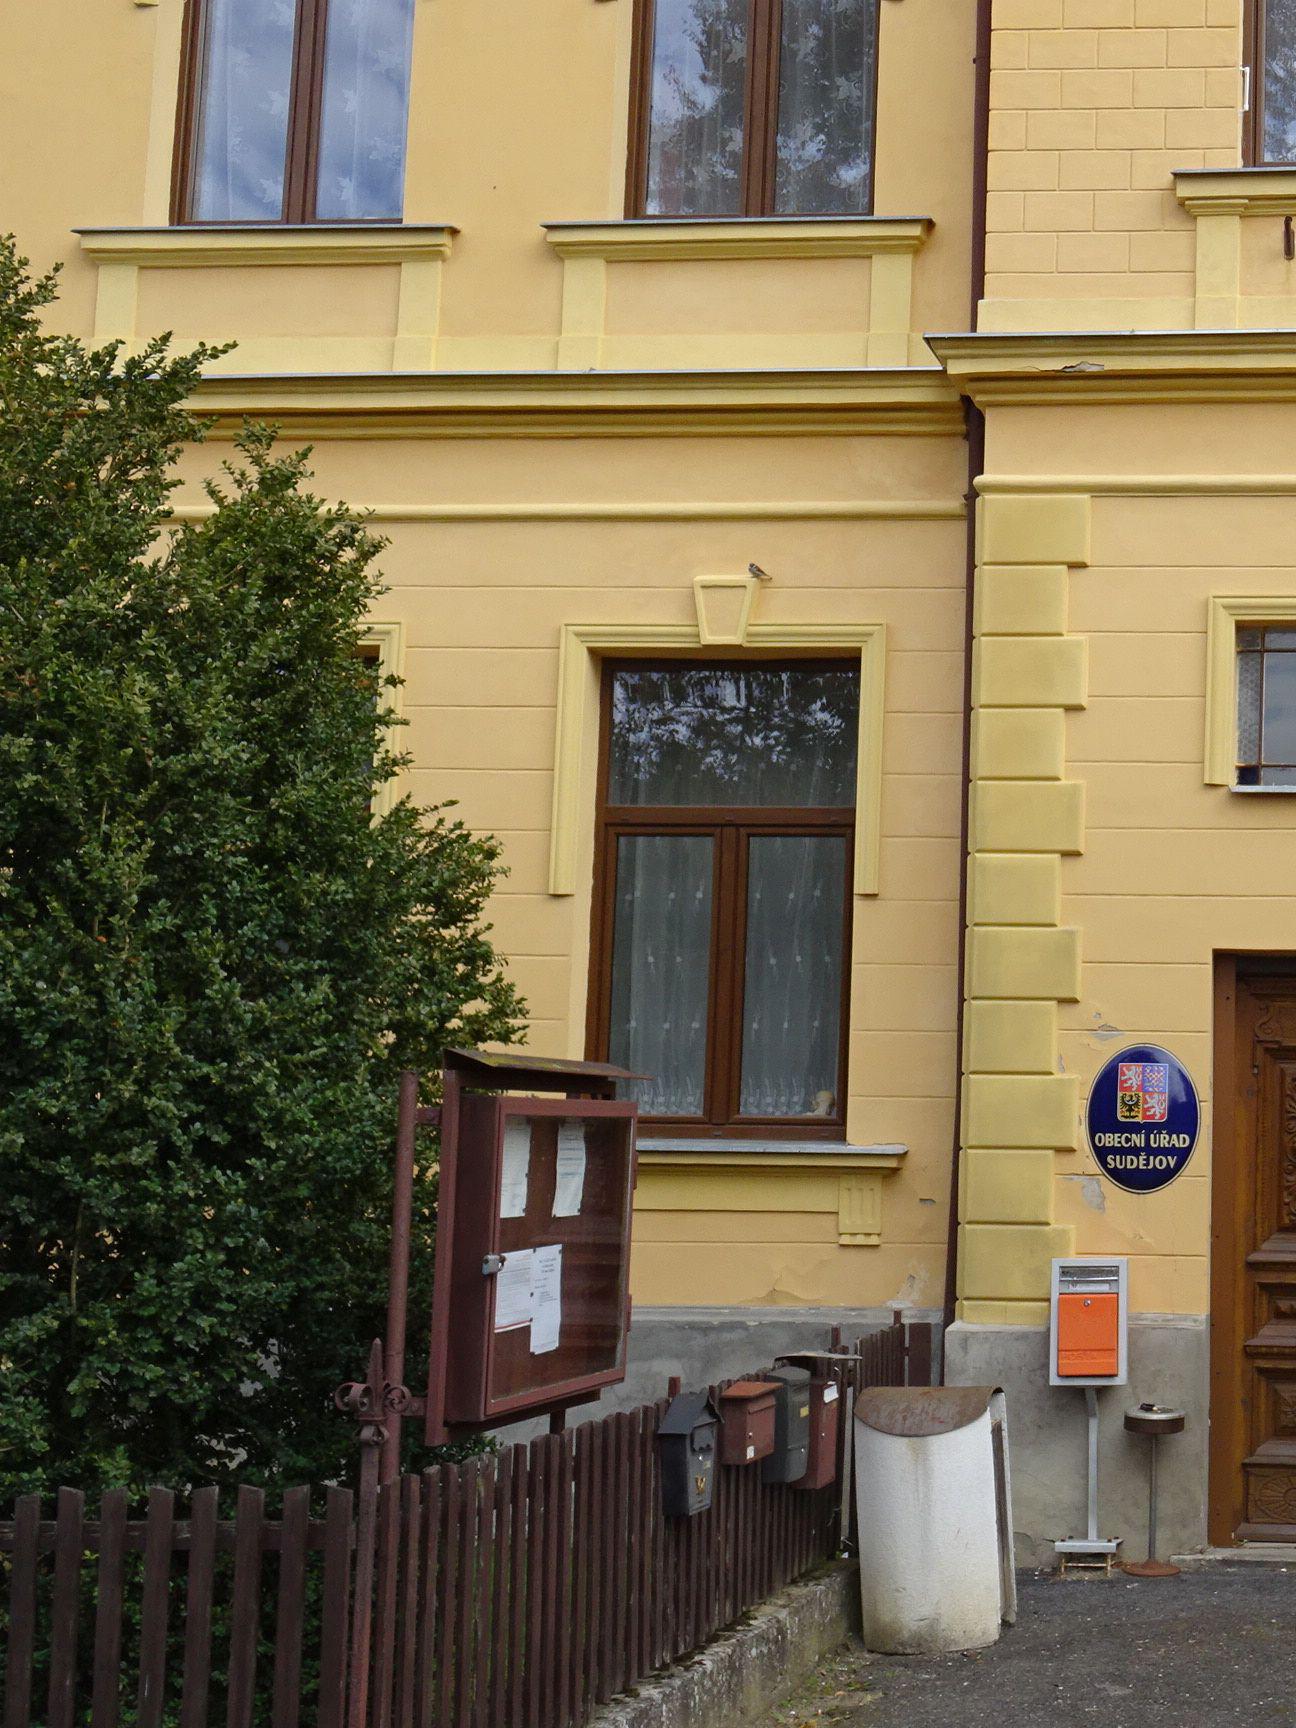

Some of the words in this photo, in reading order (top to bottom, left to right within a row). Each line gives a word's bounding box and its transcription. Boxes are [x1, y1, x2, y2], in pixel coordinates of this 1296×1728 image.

[1094, 1130, 1146, 1147] OBECNÍ
[1150, 1130, 1190, 1147] ÚŘAD
[1106, 1152, 1177, 1169] SUDĚJOV
